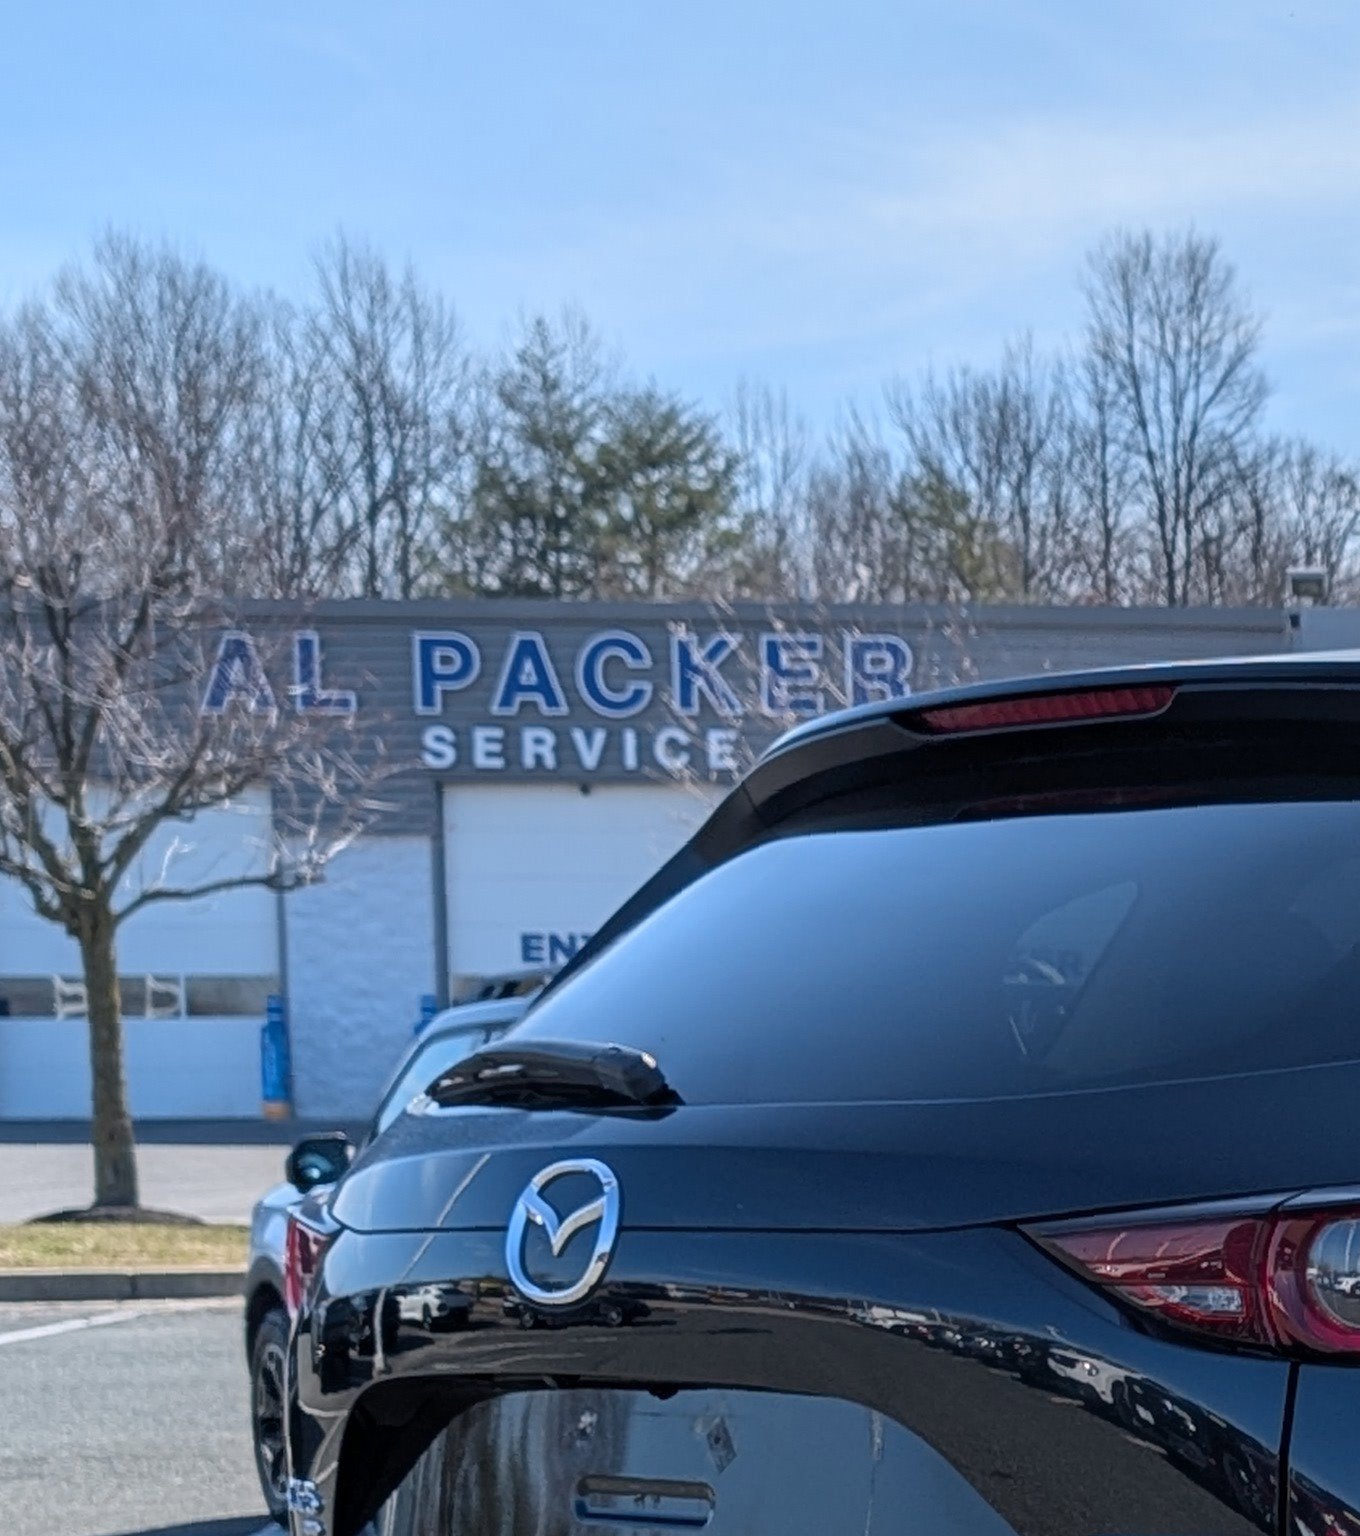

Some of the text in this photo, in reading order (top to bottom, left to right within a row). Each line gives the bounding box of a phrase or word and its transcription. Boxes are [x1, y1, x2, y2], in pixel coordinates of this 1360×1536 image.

[201, 629, 914, 719] AL PACKER
[421, 725, 739, 772] SERVICE
[522, 933, 592, 961] EN
